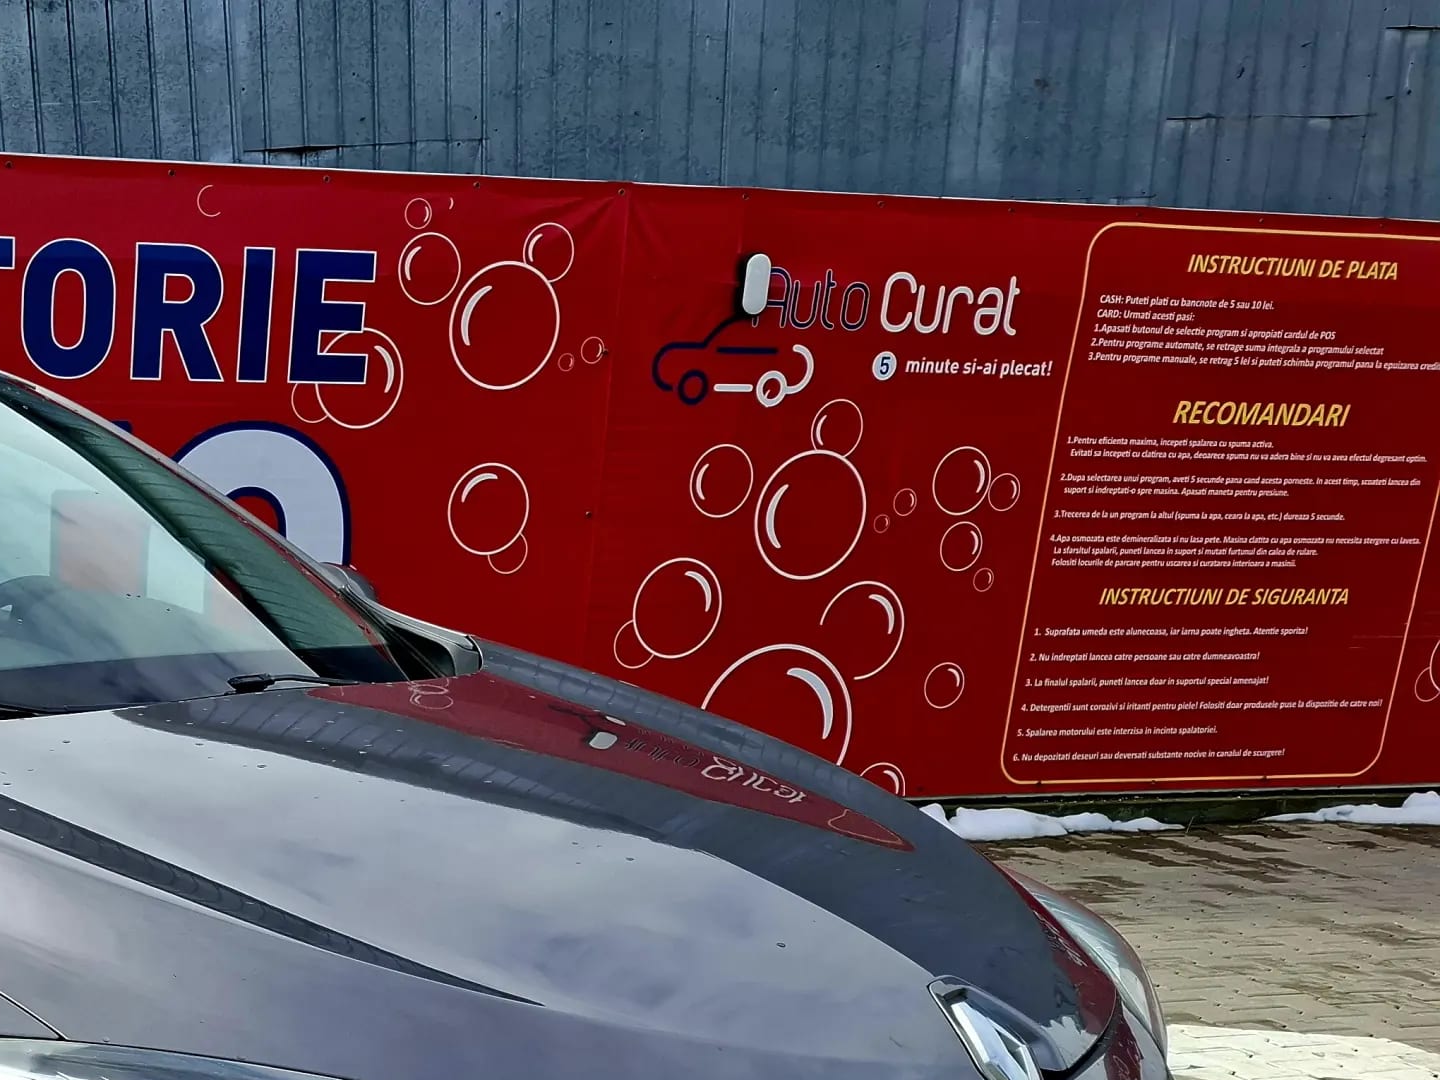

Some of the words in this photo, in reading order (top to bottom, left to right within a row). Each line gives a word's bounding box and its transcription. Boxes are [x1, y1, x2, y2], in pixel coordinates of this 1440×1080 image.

[1188, 254, 1316, 275] INSTRUCTIUNI
[1319, 260, 1345, 276] DE
[1346, 261, 1398, 280] PLATA
[880, 271, 1021, 336] Curat
[1100, 295, 1124, 304] CASH:
[1125, 296, 1150, 305] Puteti
[1150, 297, 1169, 307] plati
[1181, 298, 1218, 308] bancnote
[1262, 301, 1274, 310] lei.
[1097, 309, 1122, 318] CARD:
[1124, 310, 1152, 320] Urmati
[1152, 312, 1176, 321] acesti
[1176, 313, 1195, 322] pasi:
[1094, 324, 1131, 334] 1.Apasati
[1132, 325, 1164, 334] butonul
[1176, 326, 1206, 336] selectie
[1206, 330, 1239, 338] program
[1248, 330, 1284, 340] apropiati
[1284, 330, 1308, 339] cardul
[1320, 332, 1336, 340] POS
[1091, 338, 1125, 347] 2.Pentru
[1125, 341, 1164, 350] programe
[1165, 342, 1204, 351] automate,
[1216, 343, 1244, 353] retrage
[1267, 344, 1301, 354] integrala
[1308, 346, 1355, 355] programului
[1355, 346, 1384, 355] selectat
[879, 356, 891, 375] 5
[905, 358, 960, 375] minute
[962, 359, 998, 375] si-ai
[1000, 360, 1053, 379] plecat!
[1088, 352, 1122, 361] 3.Pentru
[1123, 355, 1161, 364] programe
[1162, 355, 1198, 365] manuale,
[1209, 357, 1233, 367] retrag
[1240, 357, 1251, 365] lei
[1259, 358, 1283, 367] puteti
[1283, 358, 1315, 367] schimba
[1315, 360, 1355, 369] programul
[1355, 362, 1374, 370] pana
[1384, 361, 1419, 371] epuizarea
[1172, 401, 1351, 427] RECOMANDARI
[1067, 436, 1097, 445] 1.Pentru
[1098, 437, 1128, 445] eficienta
[1129, 438, 1159, 446] maxima,
[1160, 439, 1188, 448] incepeti
[1189, 439, 1218, 448] spalarea
[1099, 588, 1224, 605] INSTRUCTIUNI
[1225, 589, 1251, 605] DE
[1252, 589, 1349, 605] SIGURANTA
[1045, 627, 1081, 637] Suprafata
[1082, 628, 1108, 636] umeda
[1126, 628, 1168, 636] alunecoasa,
[1200, 628, 1222, 637] poate
[1223, 627, 1252, 637] ingheta.
[1281, 627, 1308, 636] sporita!
[1051, 653, 1088, 662] indreptati
[1089, 653, 1113, 661] lancea
[1134, 654, 1168, 662] persoane
[1202, 652, 1260, 660] dumneavoastra!
[1045, 678, 1068, 686] finalul
[1069, 678, 1098, 688] spalarii,
[1099, 678, 1124, 687] puneti
[1125, 678, 1148, 686] lancea
[1150, 678, 1167, 686] doar
[1176, 677, 1207, 686] suportul
[1207, 677, 1232, 686] special
[1233, 676, 1269, 686] amenajat!
[1030, 703, 1072, 713] Detergentii
[1090, 703, 1118, 711] corozivi
[1152, 703, 1177, 711] pentru
[1177, 702, 1199, 711] piele!
[1226, 701, 1243, 709] doar
[1243, 701, 1279, 710] produsele
[1306, 700, 1339, 709] dispozitie
[1368, 699, 1383, 707] noi!
[1026, 729, 1058, 738] Spalarea
[1059, 728, 1096, 736] motorului
[1113, 727, 1144, 735] interzisa
[1179, 726, 1218, 735] spalatoriei.
[1034, 753, 1071, 762] depozitati
[1072, 752, 1099, 760] deseuri
[1148, 751, 1183, 759] substante
[1217, 749, 1242, 757] canalul
[1253, 749, 1285, 758] scurgere!
